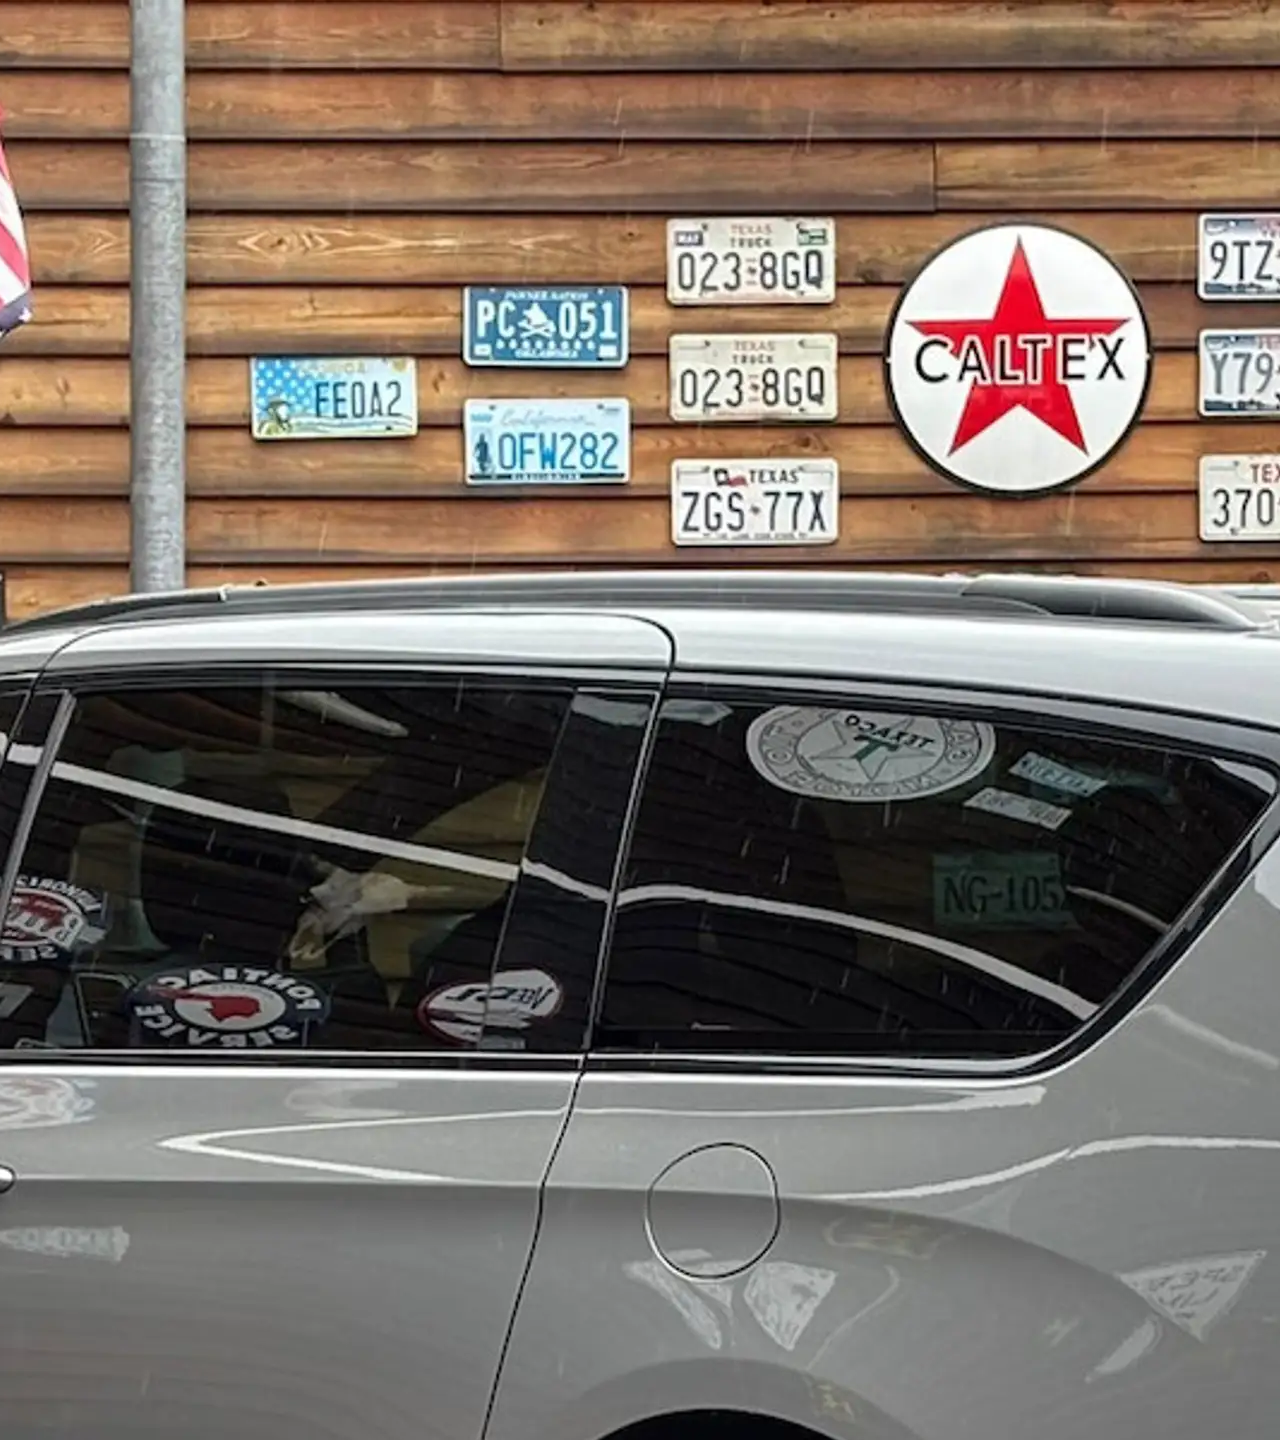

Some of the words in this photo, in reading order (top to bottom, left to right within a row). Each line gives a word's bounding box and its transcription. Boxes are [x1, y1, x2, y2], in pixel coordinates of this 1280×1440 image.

[730, 223, 773, 235] TEXAS
[477, 299, 516, 339] PC
[558, 300, 619, 340] 051
[733, 340, 776, 352] TEXAS
[913, 335, 1127, 385] CALTEX
[748, 469, 800, 485] TEXAS
